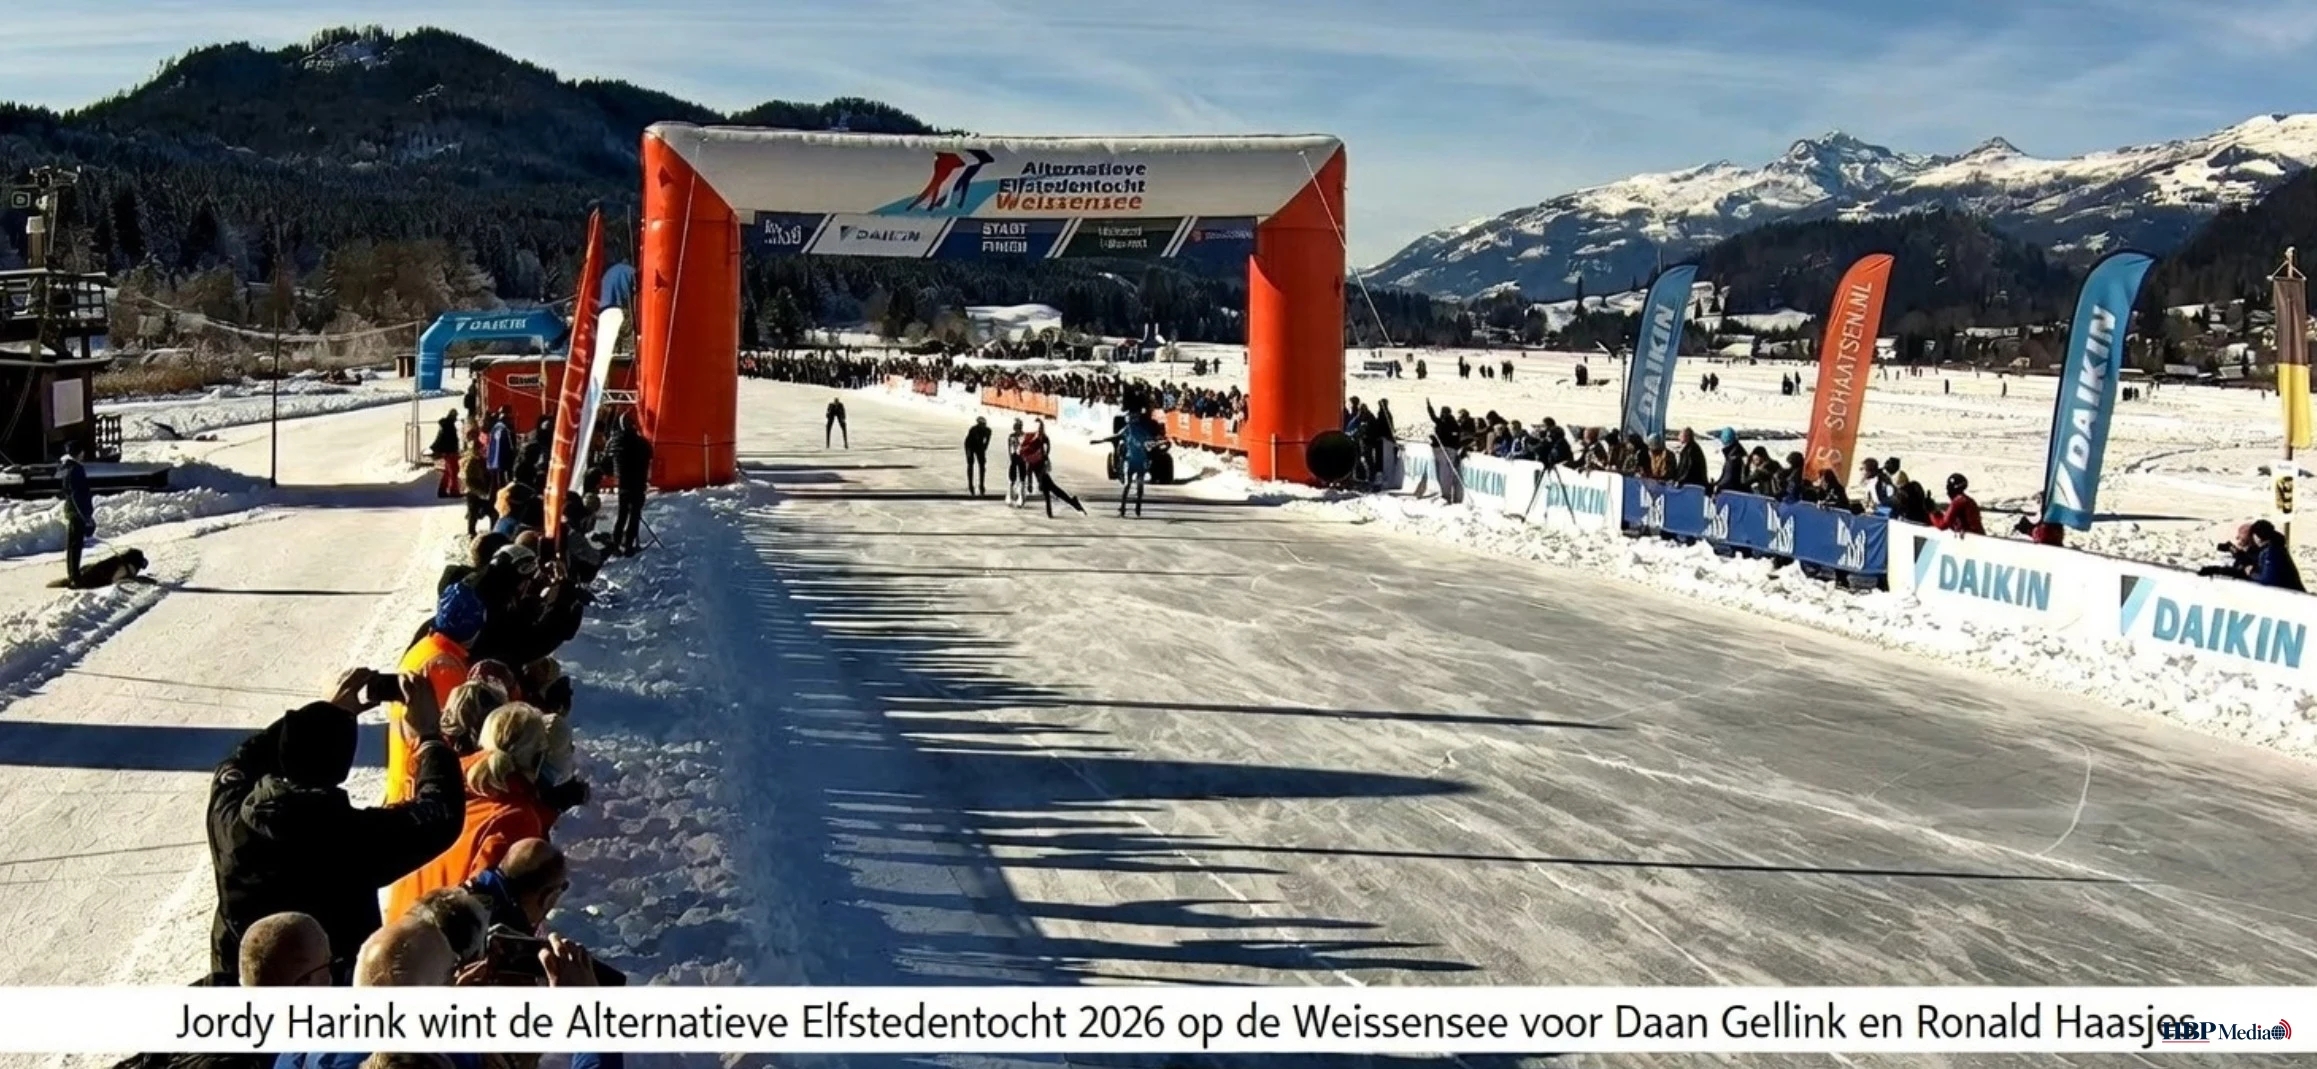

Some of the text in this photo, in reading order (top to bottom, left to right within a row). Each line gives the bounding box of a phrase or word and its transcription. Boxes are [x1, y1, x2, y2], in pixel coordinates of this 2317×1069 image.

[996, 194, 1143, 211] Weissensee
[1641, 303, 1675, 417] DAIKIN
[2066, 304, 2117, 472] DAIKIN
[1461, 464, 1507, 498] AIKIN
[1938, 554, 2052, 611] DAIKIN
[2152, 596, 2308, 669] DAIKIN
